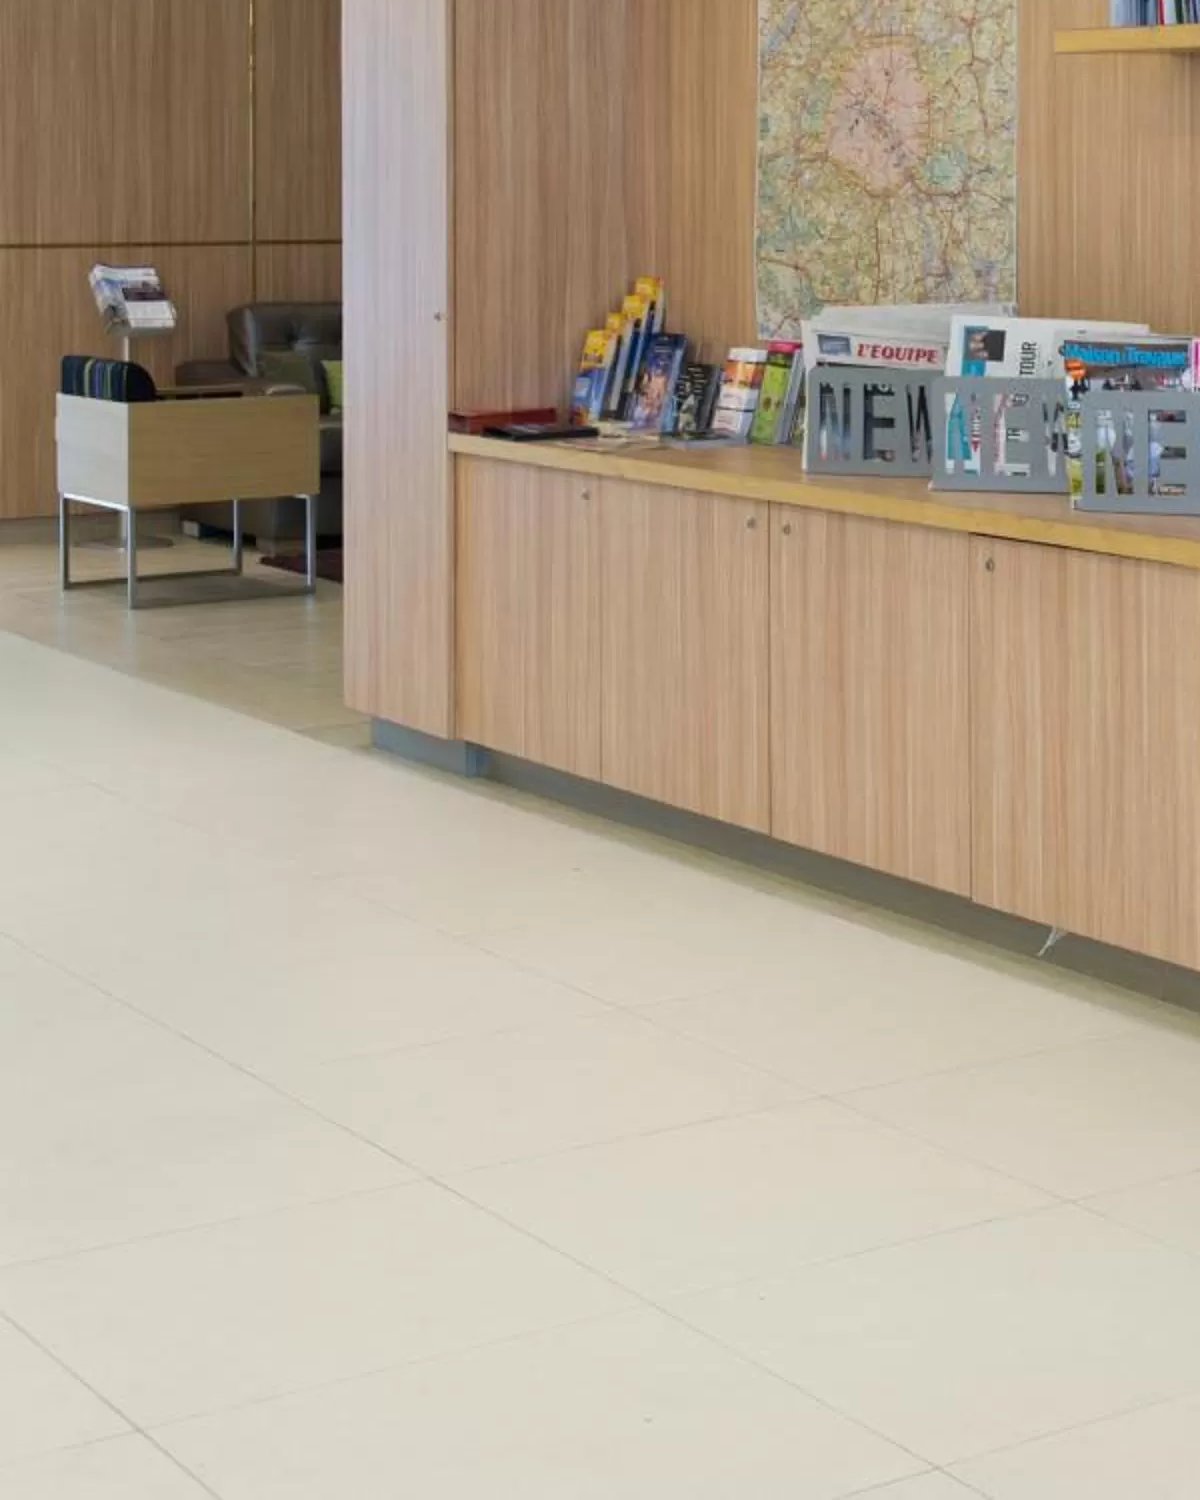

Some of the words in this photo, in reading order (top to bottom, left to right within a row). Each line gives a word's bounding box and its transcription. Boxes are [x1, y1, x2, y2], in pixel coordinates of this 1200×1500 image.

[1019, 341, 1038, 376] TOUR
[819, 382, 933, 463] NEW
[944, 390, 1069, 477] NEW
